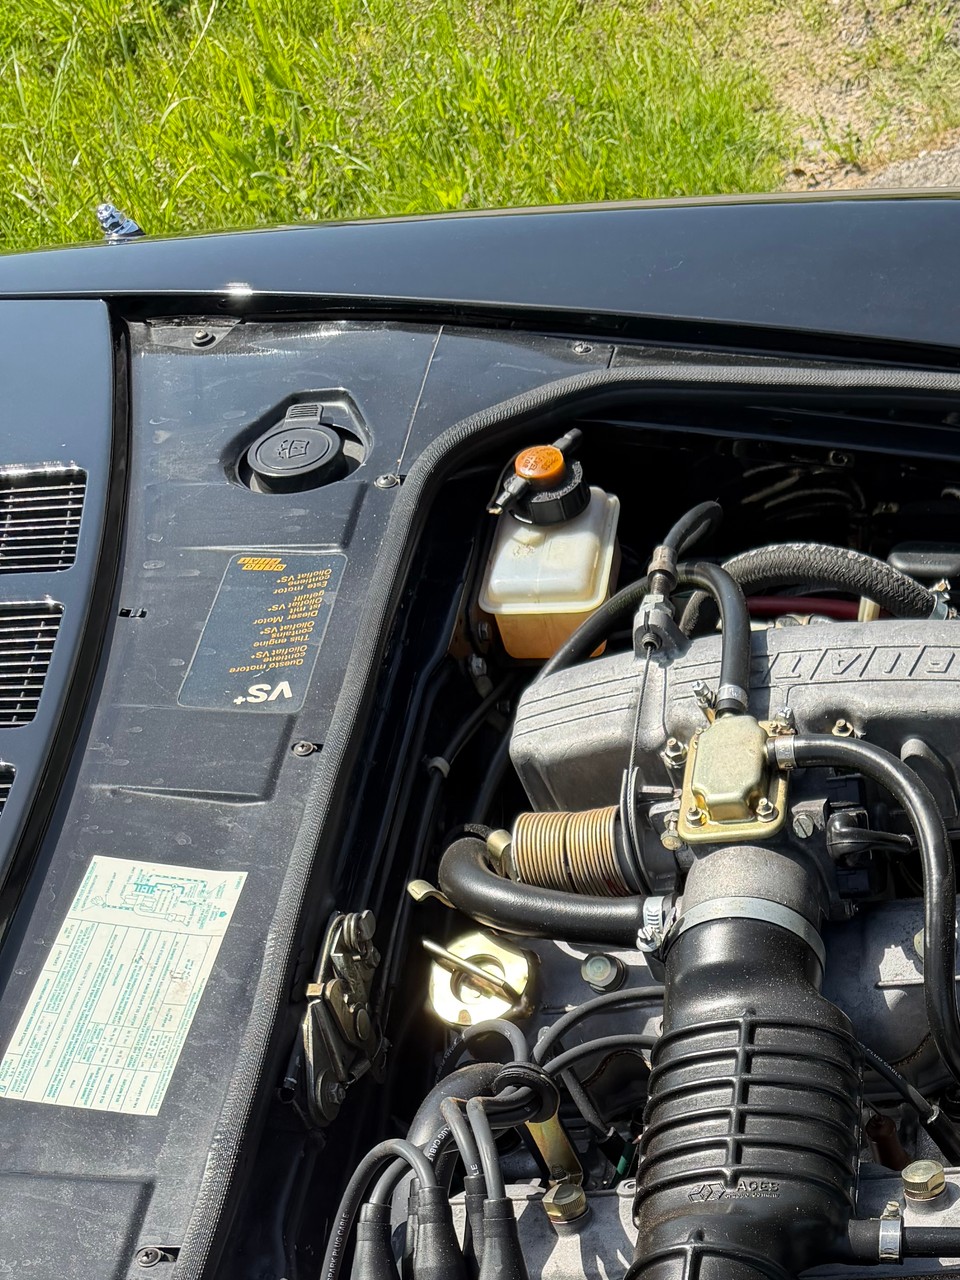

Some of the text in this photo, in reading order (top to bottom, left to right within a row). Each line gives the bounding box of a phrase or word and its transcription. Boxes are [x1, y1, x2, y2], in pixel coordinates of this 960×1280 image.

[287, 574, 331, 585] contiene
[273, 580, 328, 594] Este motor
[288, 597, 322, 607] Oliofiat
[253, 610, 318, 625] Dieser Motor
[280, 620, 315, 631] Oliofiat
[271, 628, 313, 638] contains
[253, 637, 287, 648] engine
[272, 645, 308, 655] Oliofiat
[263, 652, 306, 663] contiene
[229, 659, 303, 673] Questo motore
[775, 653, 955, 680] FIAT
[337, 1212, 350, 1235] CABLE
[332, 1236, 343, 1256] PLUG
